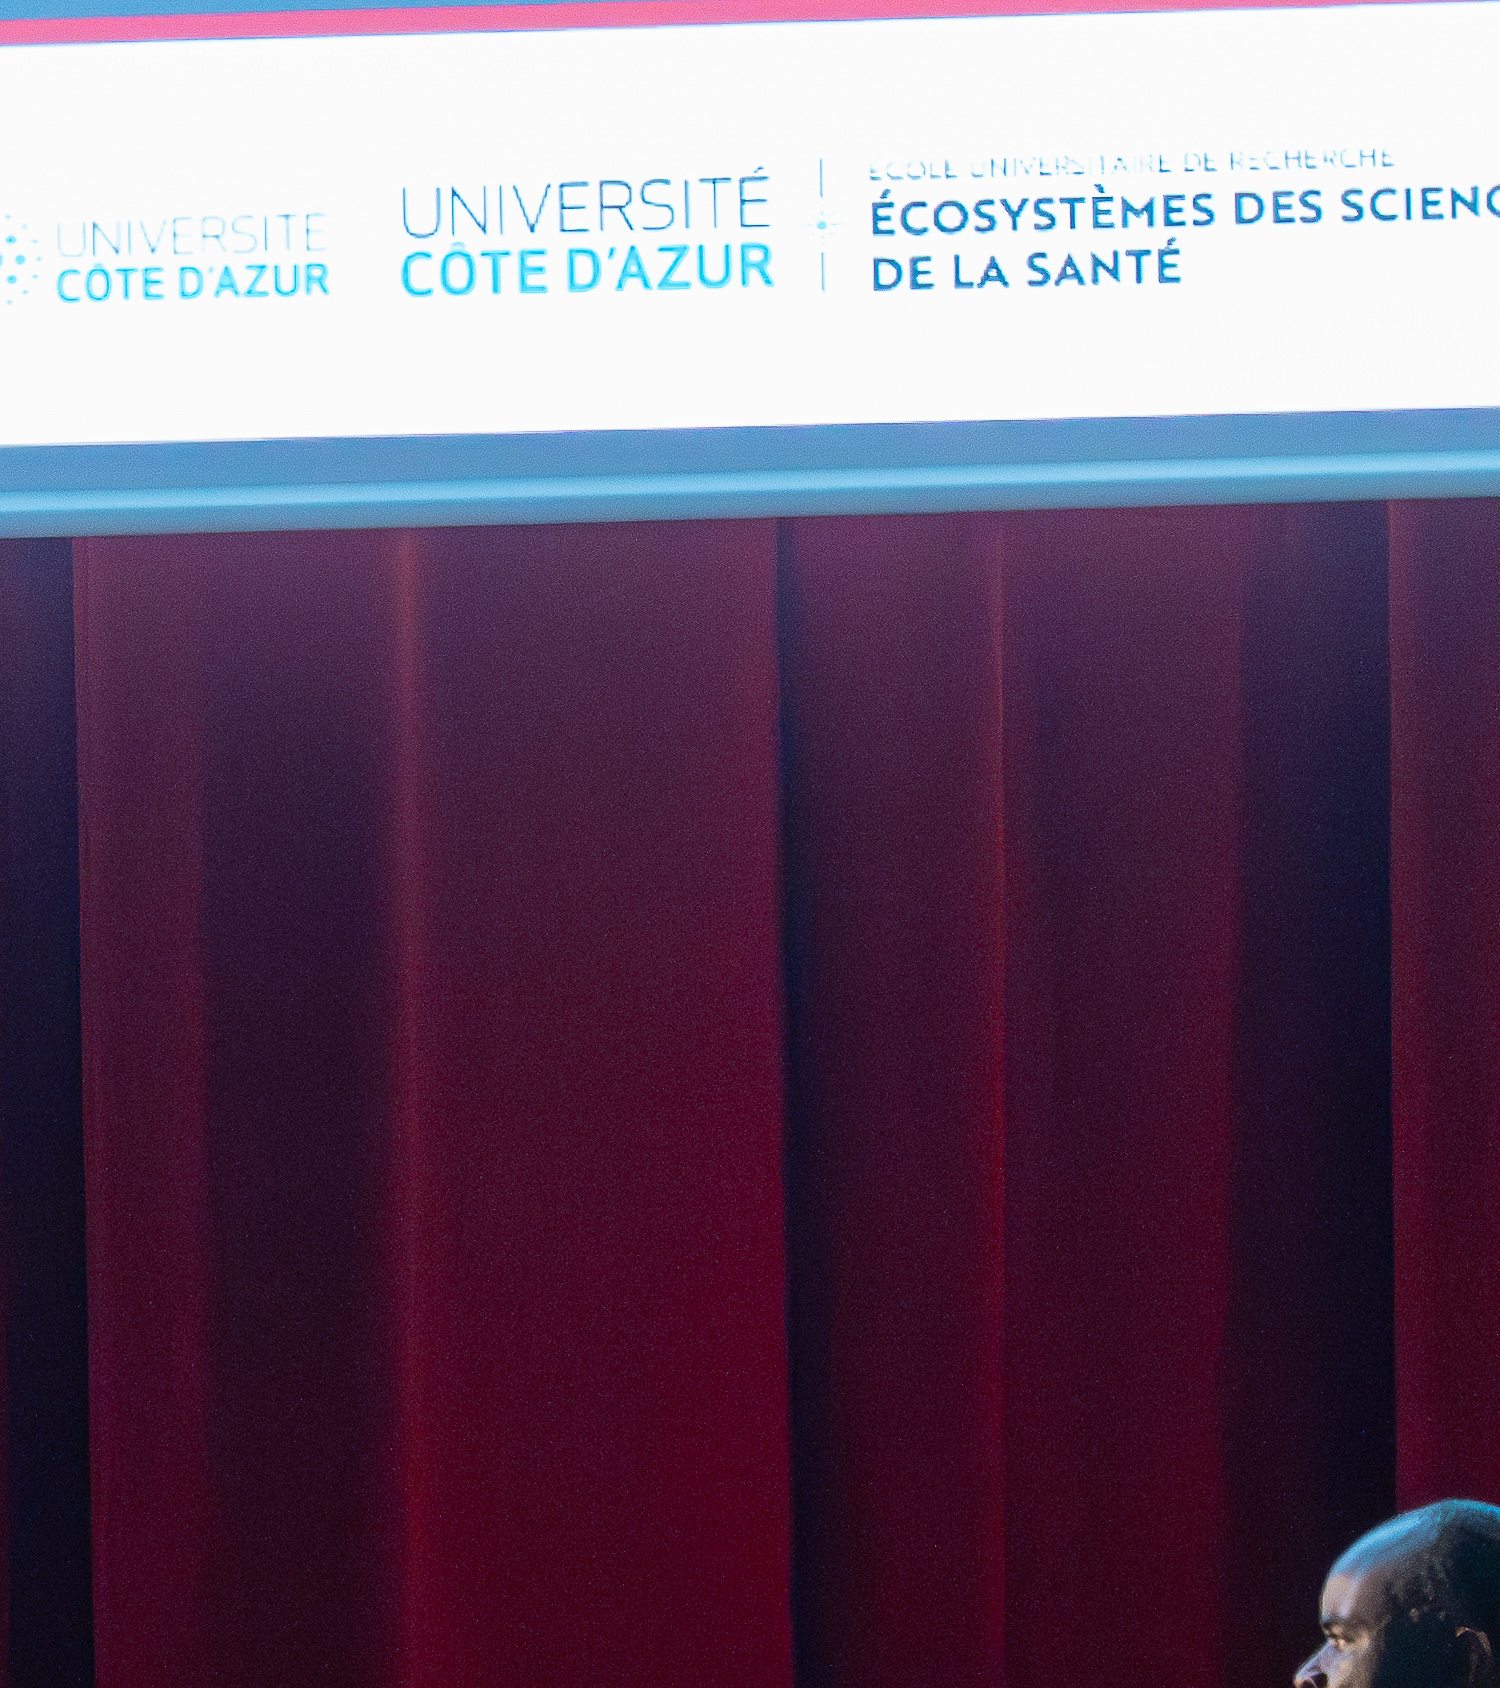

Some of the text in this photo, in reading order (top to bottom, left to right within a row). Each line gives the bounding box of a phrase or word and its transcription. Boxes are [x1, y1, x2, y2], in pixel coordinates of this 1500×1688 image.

[402, 166, 771, 239] UNIVERSITÉ
[871, 183, 1216, 237] ÉCOSYSTÈMES
[1234, 188, 1323, 225] DES
[56, 262, 331, 303] CÔTE D'AZUR
[402, 241, 775, 298] CÔTE D'AZUR
[872, 236, 1183, 292] DE LA SANTÉ
